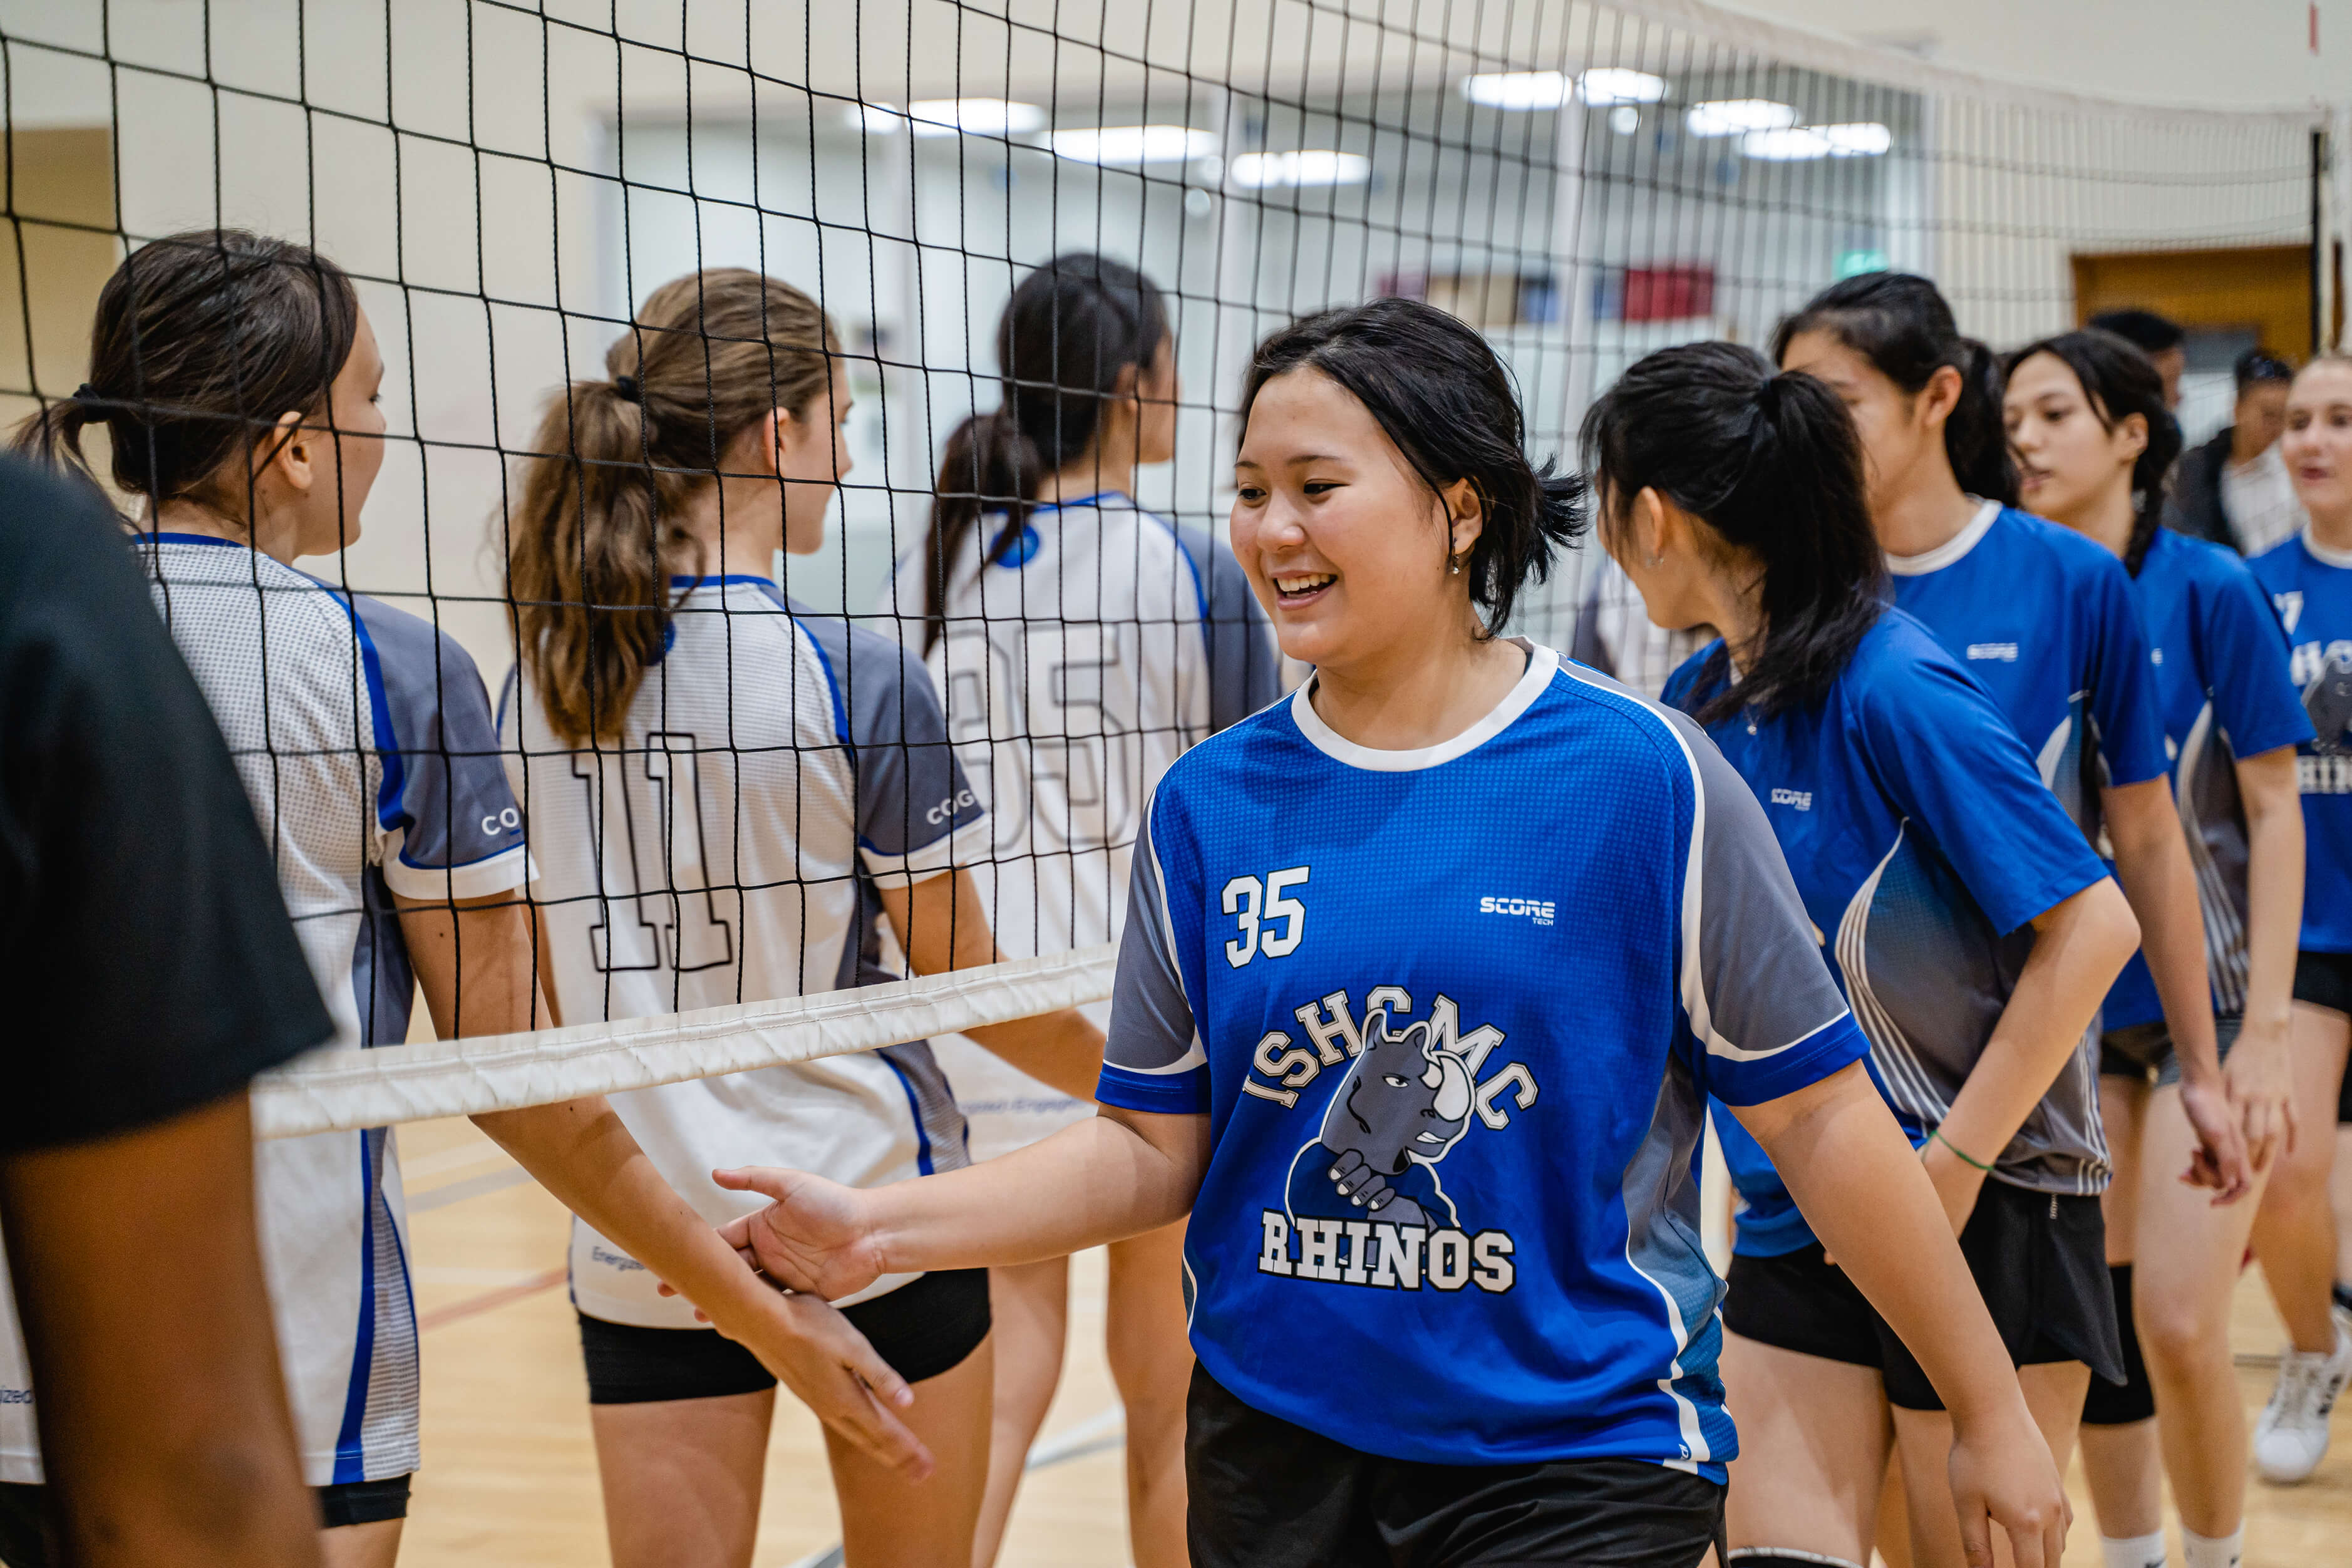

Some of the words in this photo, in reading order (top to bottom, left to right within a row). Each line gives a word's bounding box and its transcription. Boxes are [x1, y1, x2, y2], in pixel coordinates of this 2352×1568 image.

[570, 731, 733, 972] 11
[1222, 865, 1311, 969] 35
[1480, 897, 1555, 919] SCORE
[1532, 917, 1554, 926] TECH
[1257, 1208, 1516, 1293] RHINOS
